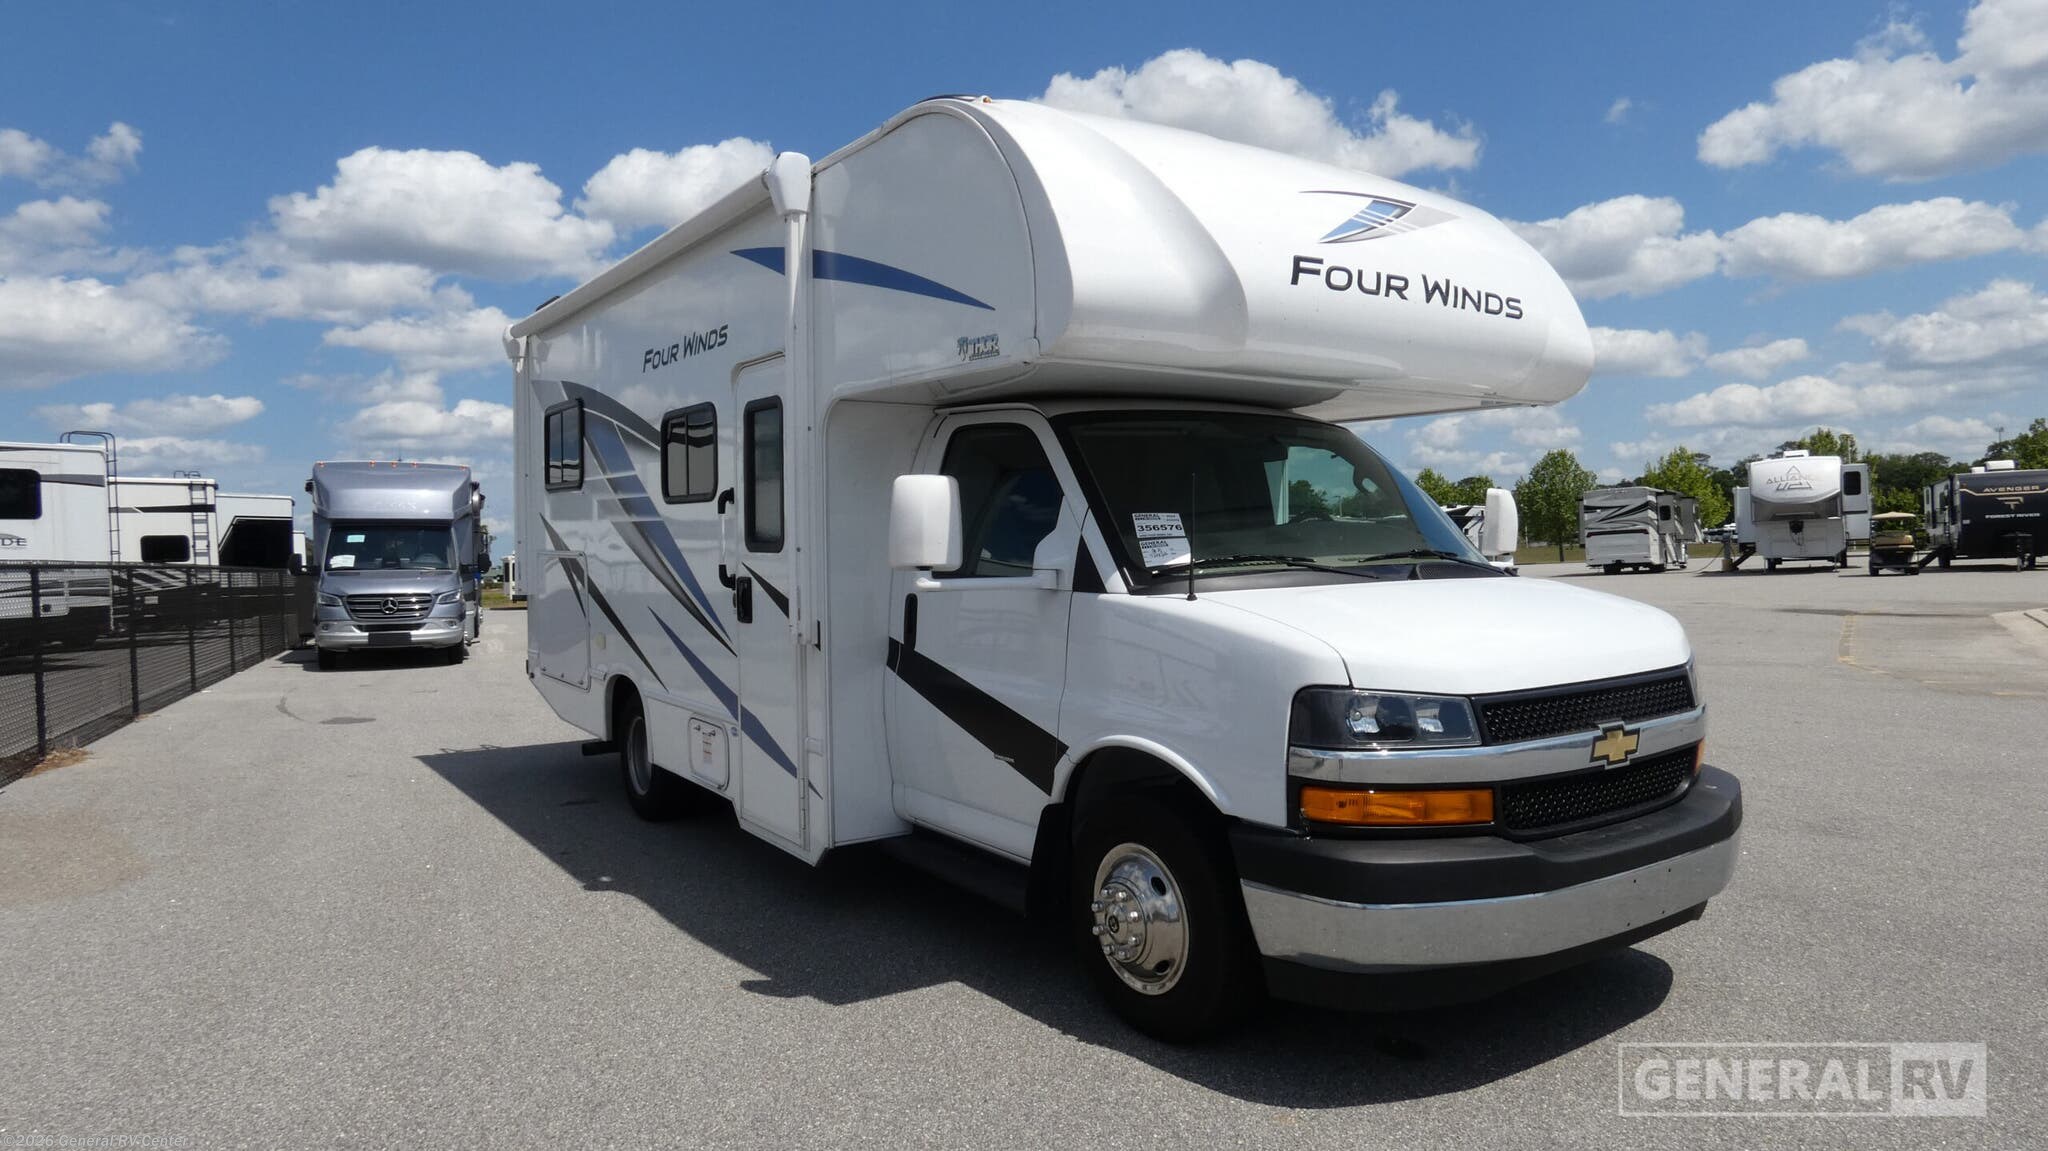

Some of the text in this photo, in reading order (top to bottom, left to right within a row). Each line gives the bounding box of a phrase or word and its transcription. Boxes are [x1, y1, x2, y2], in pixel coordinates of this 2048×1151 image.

[1290, 255, 1524, 320] FOUR WINDS
[642, 324, 728, 373] FOUR WINDS
